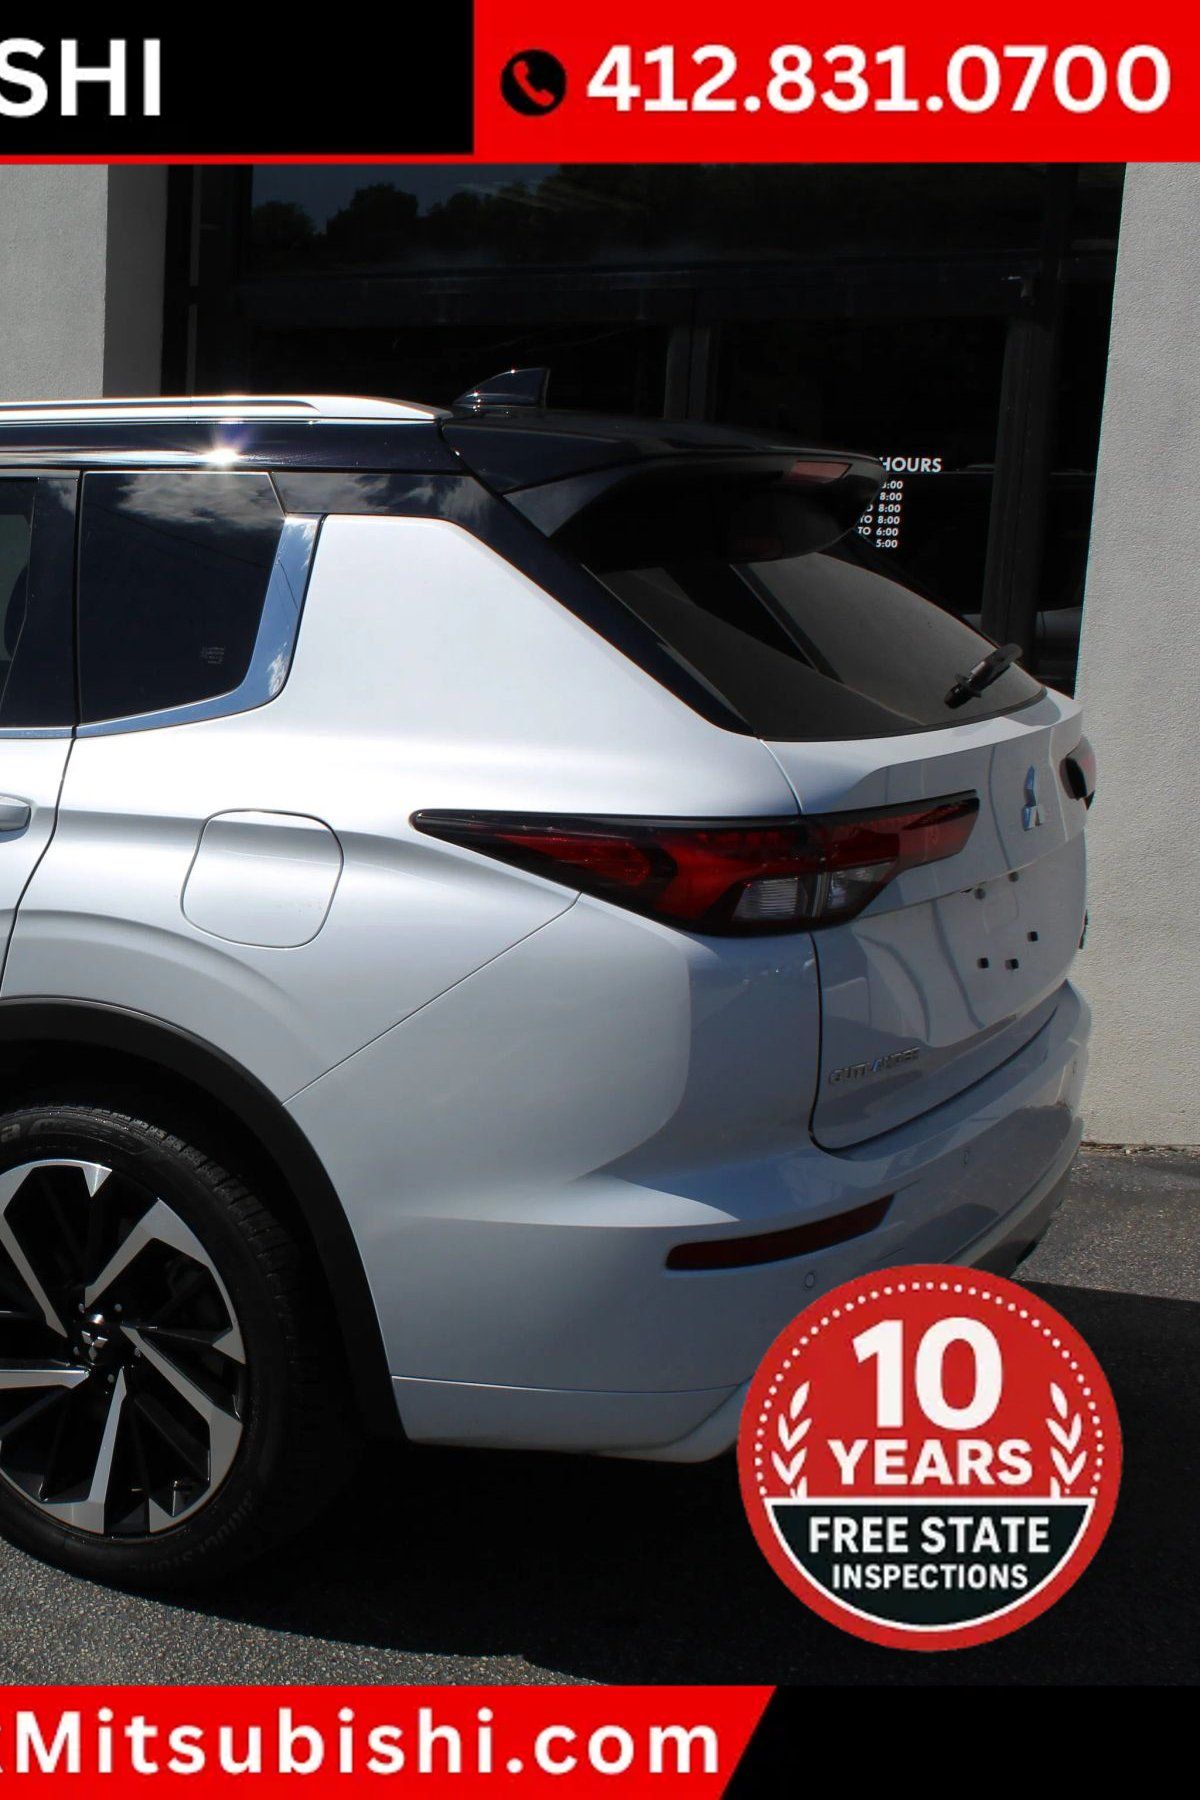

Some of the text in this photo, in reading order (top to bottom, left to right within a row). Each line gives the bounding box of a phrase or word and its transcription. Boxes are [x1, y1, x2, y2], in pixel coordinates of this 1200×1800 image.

[880, 457, 942, 473] HOURS
[880, 492, 902, 501] 8:00
[878, 504, 901, 513] 8:00
[877, 516, 900, 525] 8:00
[858, 526, 898, 537] TO 6:00
[875, 539, 898, 548] 5:00
